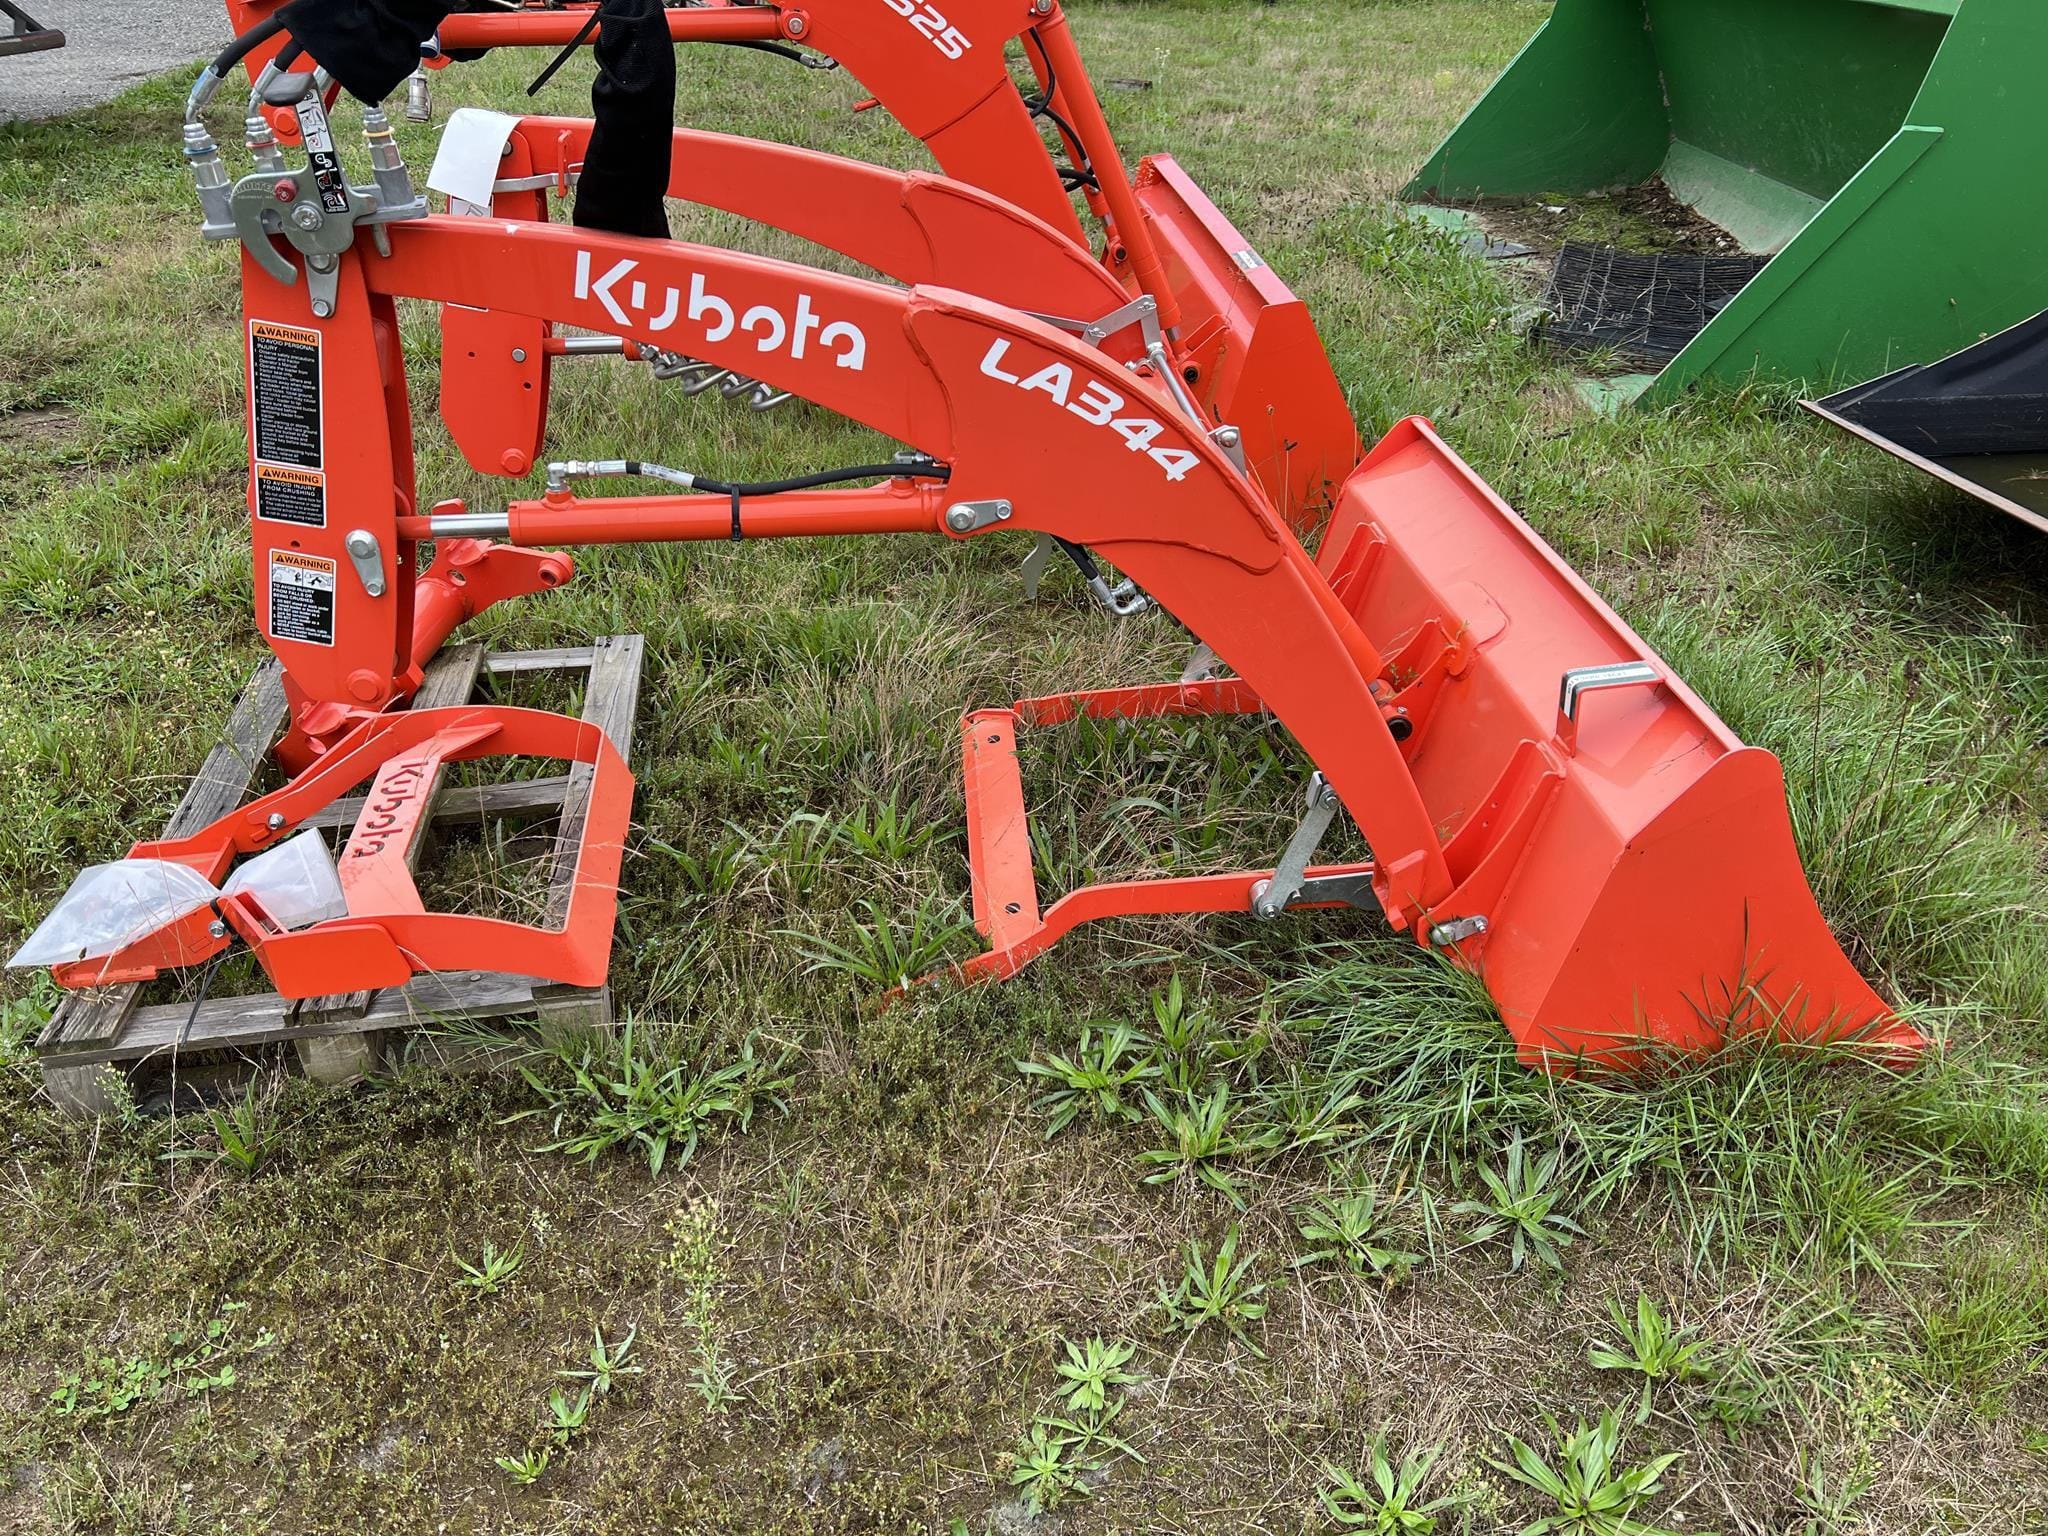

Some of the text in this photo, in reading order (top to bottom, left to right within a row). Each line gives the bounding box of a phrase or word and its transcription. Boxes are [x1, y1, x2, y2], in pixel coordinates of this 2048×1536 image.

[574, 250, 866, 371] Kubota
[266, 327, 315, 343] WARNING
[257, 343, 277, 351] INJURY
[284, 342, 315, 352] PERSONAL
[979, 338, 1200, 482] LA344
[271, 470, 319, 484] WARNING
[282, 488, 315, 497] CRUSHING
[285, 556, 330, 571] WARNING
[352, 761, 429, 858] Kubota
